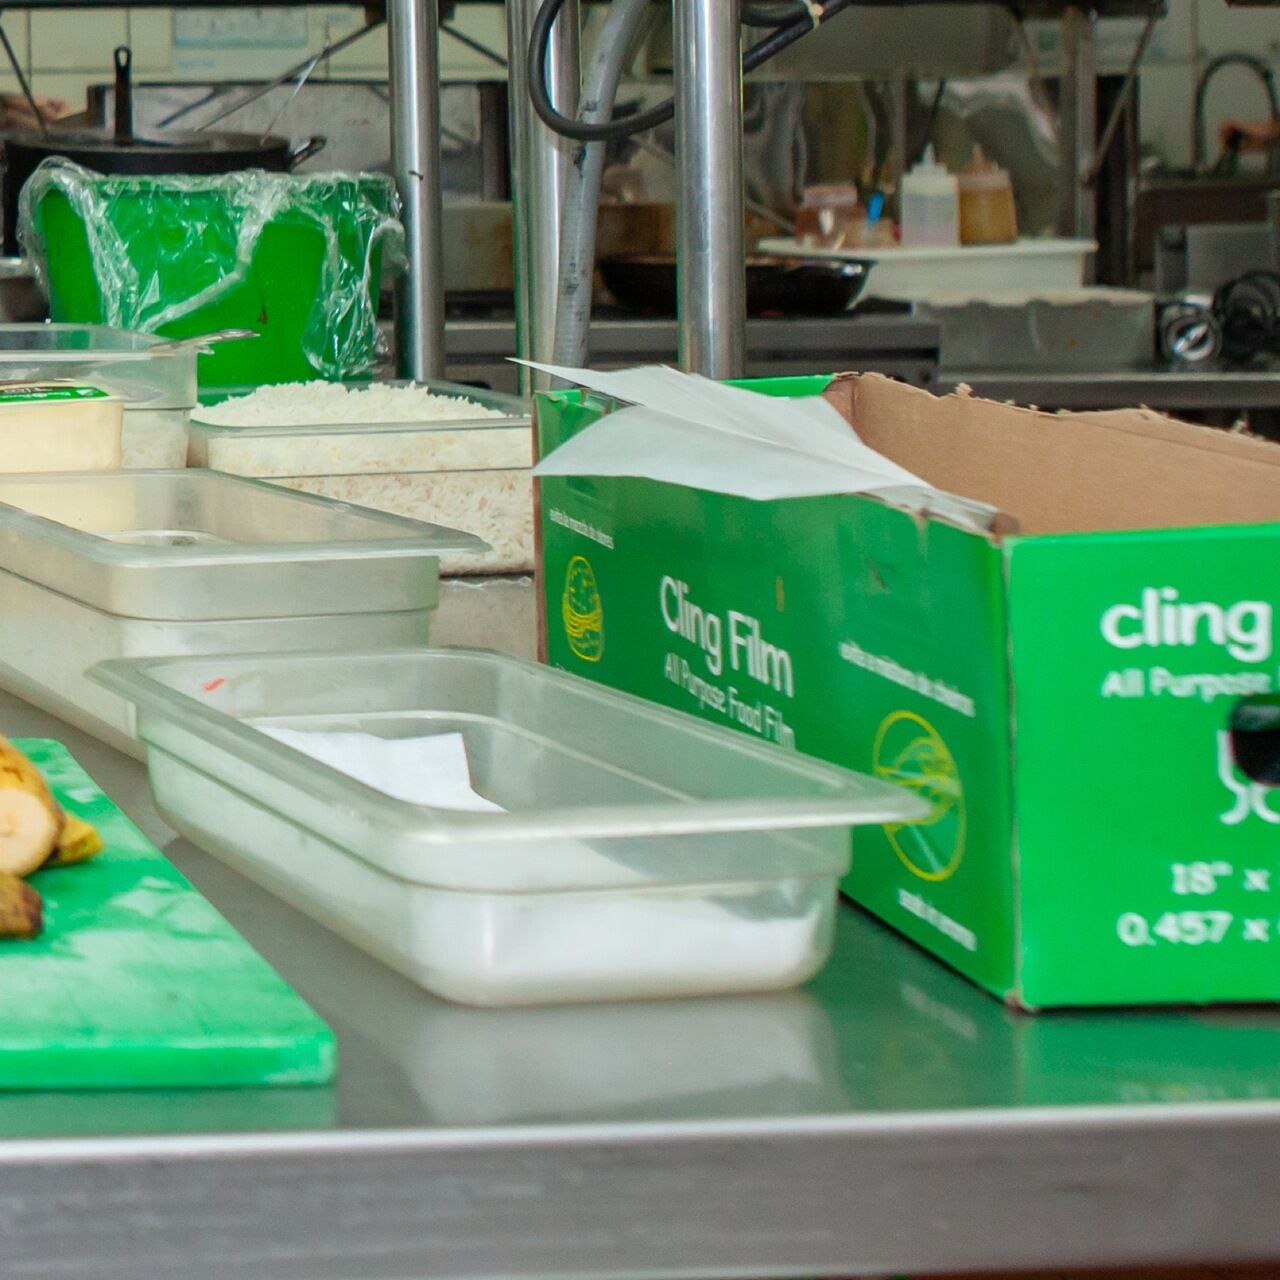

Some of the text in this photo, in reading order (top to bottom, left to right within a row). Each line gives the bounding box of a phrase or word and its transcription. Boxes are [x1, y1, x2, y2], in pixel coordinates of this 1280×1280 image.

[659, 574, 724, 676] Cling
[727, 609, 795, 698] Film
[1100, 586, 1273, 663] cling
[663, 652, 680, 687] All
[680, 658, 727, 713] Purpose
[727, 685, 762, 734] Food
[1100, 666, 1272, 703] All Purpose
[1243, 868, 1271, 893] x
[1116, 910, 1271, 947] 0.457 x
